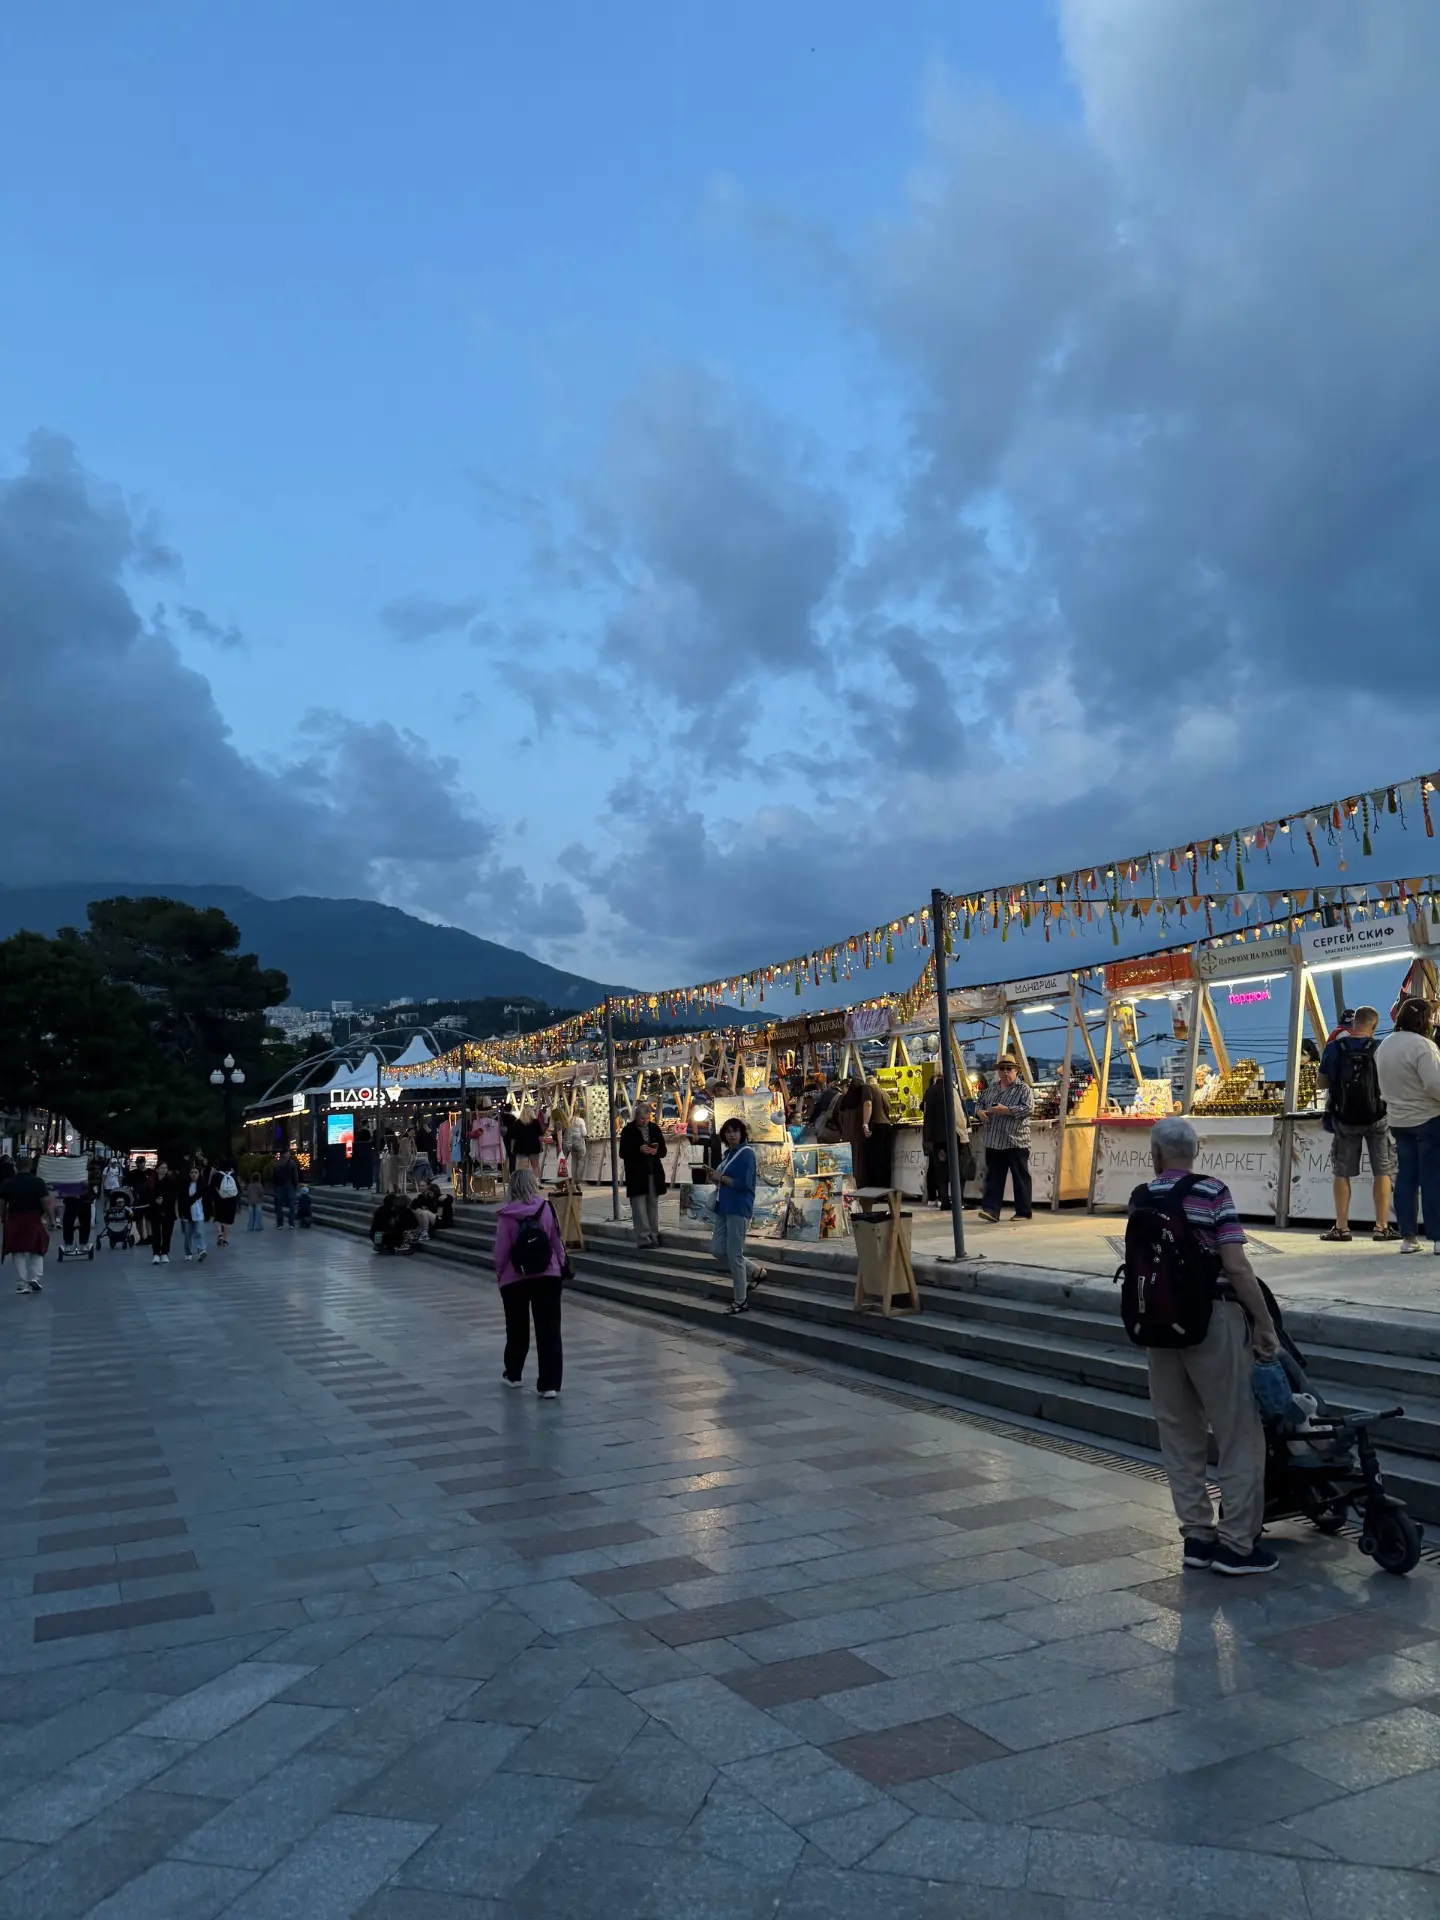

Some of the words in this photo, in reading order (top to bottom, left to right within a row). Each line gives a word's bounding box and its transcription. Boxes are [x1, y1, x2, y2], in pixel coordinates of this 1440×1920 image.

[1313, 932, 1354, 948] СЕРГЕЙ
[1358, 927, 1395, 941] СКИФ
[1219, 953, 1250, 965] ПАРФЮМ
[1250, 952, 1260, 960] НА
[1261, 947, 1288, 959] РАЗЛИВ
[1325, 946, 1351, 954] БРАСЛЕТЫ
[1360, 941, 1383, 949] КАМНЕЙ
[1228, 989, 1271, 1005] парфюм
[330, 1087, 386, 1101] ПЛОВ
[1109, 1150, 1153, 1167] МАРКЕ
[1201, 1152, 1267, 1171] МАРКЕТ
